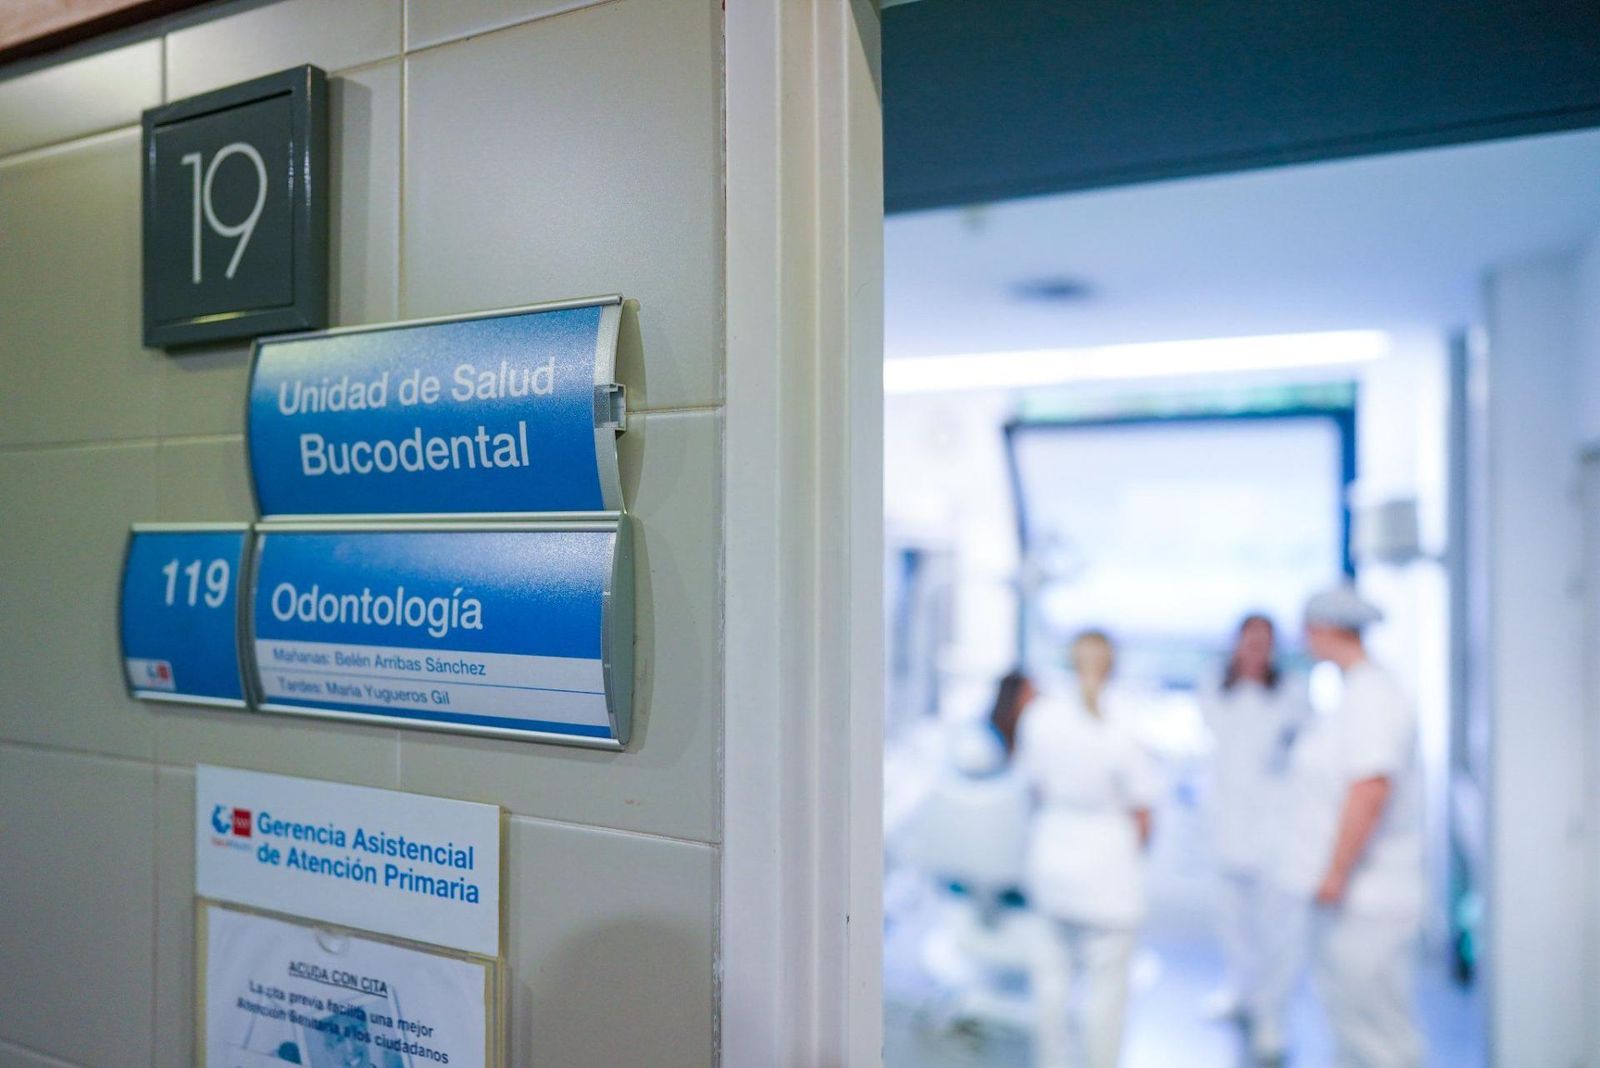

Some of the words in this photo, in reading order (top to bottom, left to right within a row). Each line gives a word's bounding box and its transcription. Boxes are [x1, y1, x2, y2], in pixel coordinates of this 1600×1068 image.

[180, 142, 268, 284] 19
[278, 371, 388, 416] Unidad
[399, 372, 441, 406] de
[451, 357, 556, 402] Salud
[299, 421, 530, 477] Bucodental
[161, 558, 230, 608] 119
[271, 582, 483, 638] Odontología
[334, 651, 371, 668] Belén
[374, 655, 422, 672] Arribas
[425, 657, 486, 676] Sánchez
[365, 686, 428, 704] Yugueros
[431, 689, 450, 705] Gil
[257, 812, 346, 848] Gerencia
[352, 828, 474, 871] Asistencial
[257, 843, 281, 865] de
[286, 847, 377, 885] Atención
[384, 864, 480, 904] Primaria
[288, 961, 329, 981] ACUDA
[332, 969, 359, 988] CON
[361, 977, 388, 994] CITA
[370, 1012, 393, 1028] una
[397, 1018, 434, 1038] mejor
[374, 1032, 449, 1064] ciudadanos
